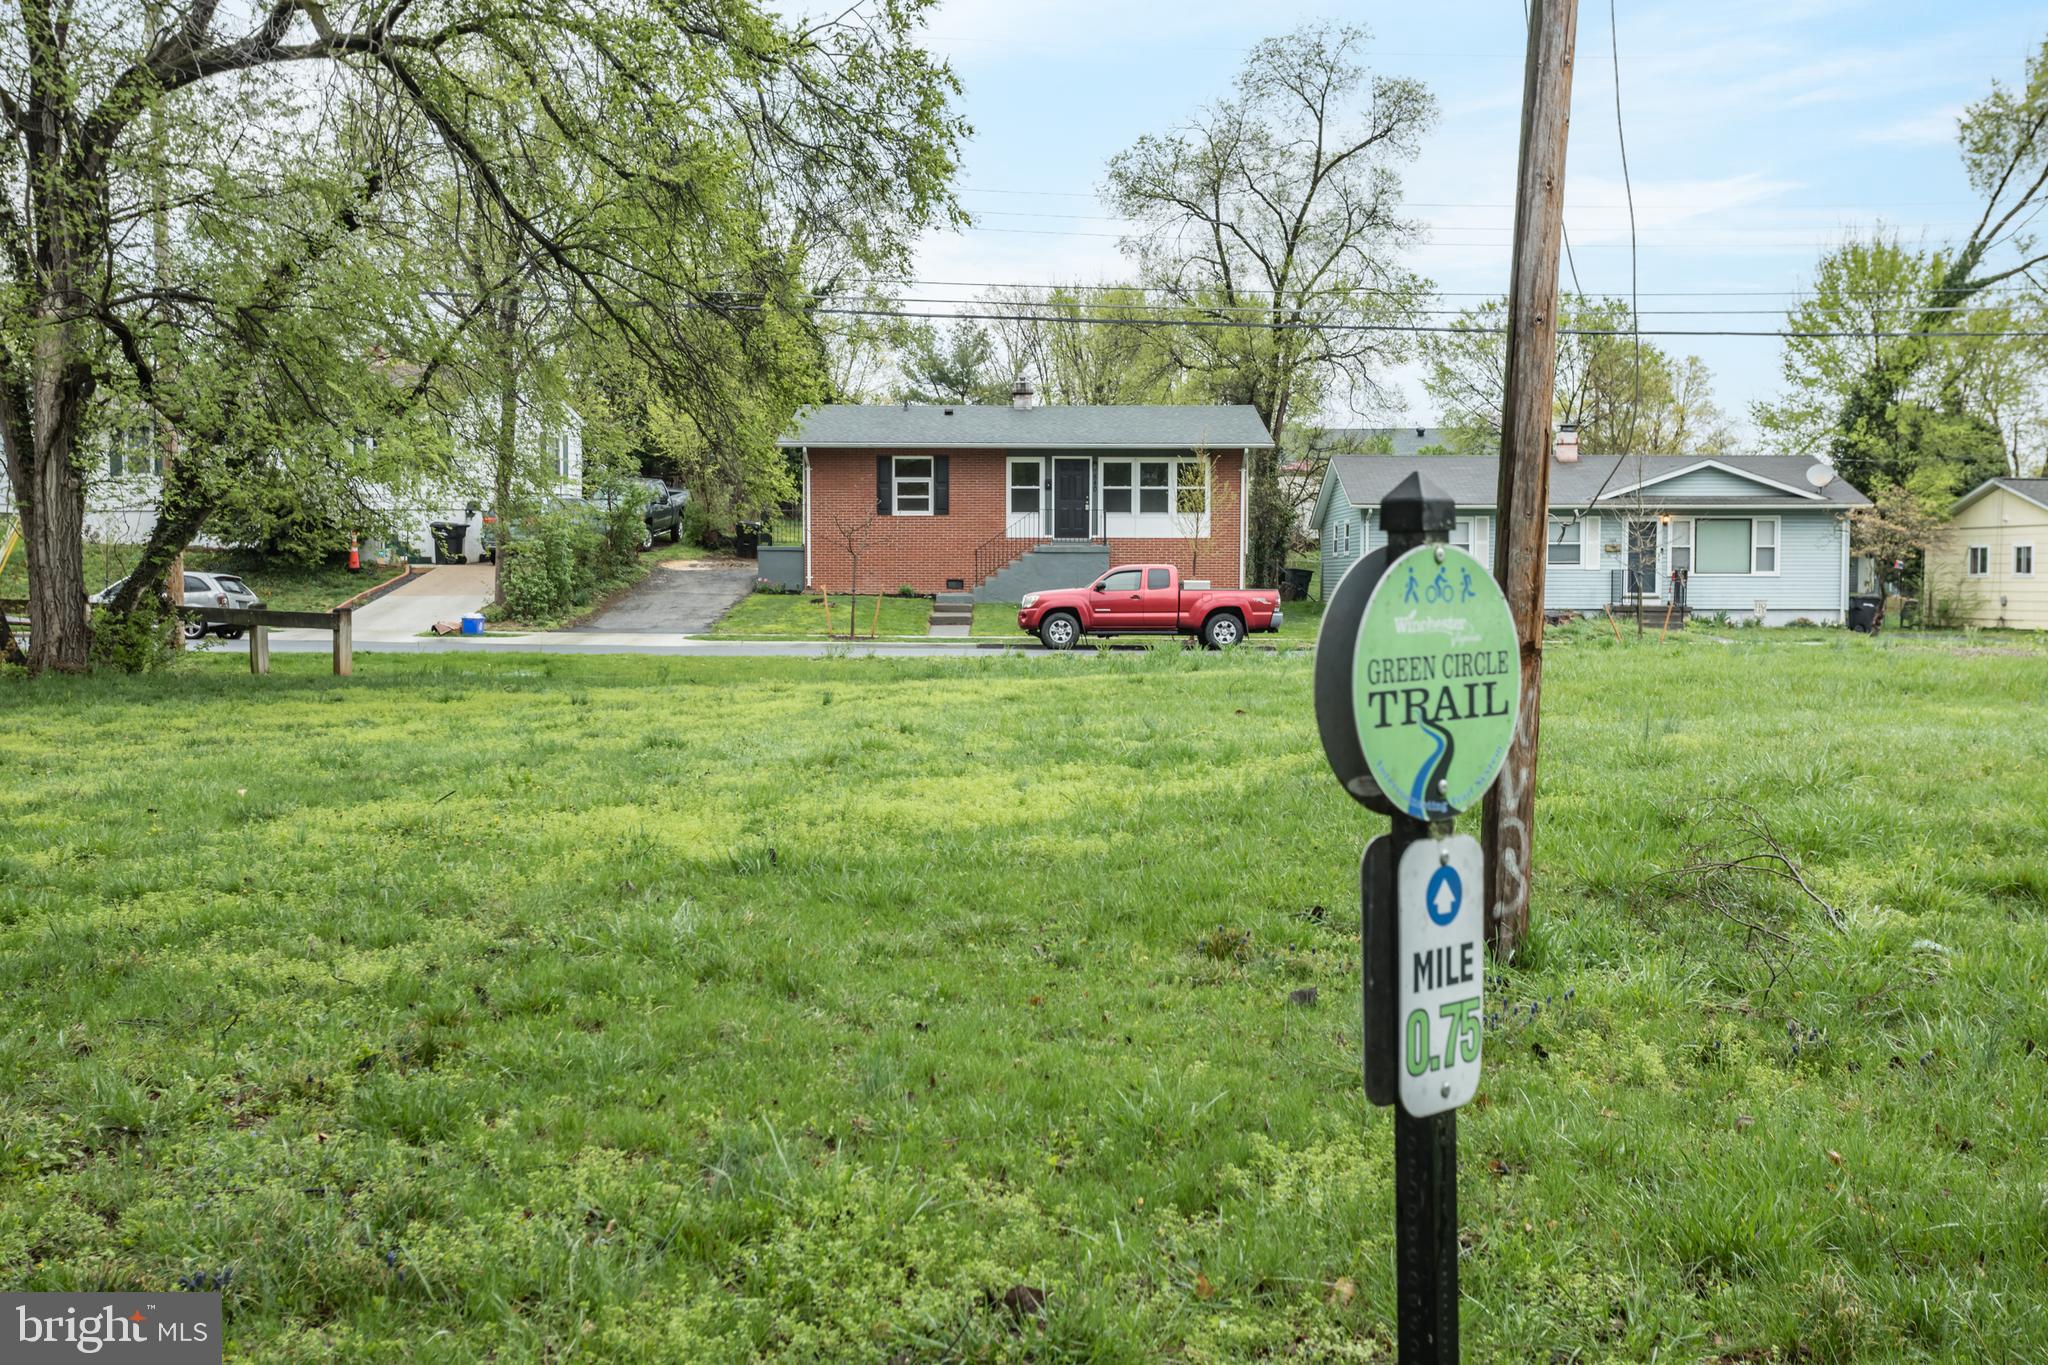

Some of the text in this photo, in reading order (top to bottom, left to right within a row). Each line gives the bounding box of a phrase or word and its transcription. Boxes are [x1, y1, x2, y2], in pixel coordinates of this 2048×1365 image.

[1367, 650, 1509, 685] GREEN CIRCLE
[1368, 681, 1509, 729] TRAIL
[1413, 942, 1474, 993] MILE
[1406, 996, 1480, 1077] 0.75
